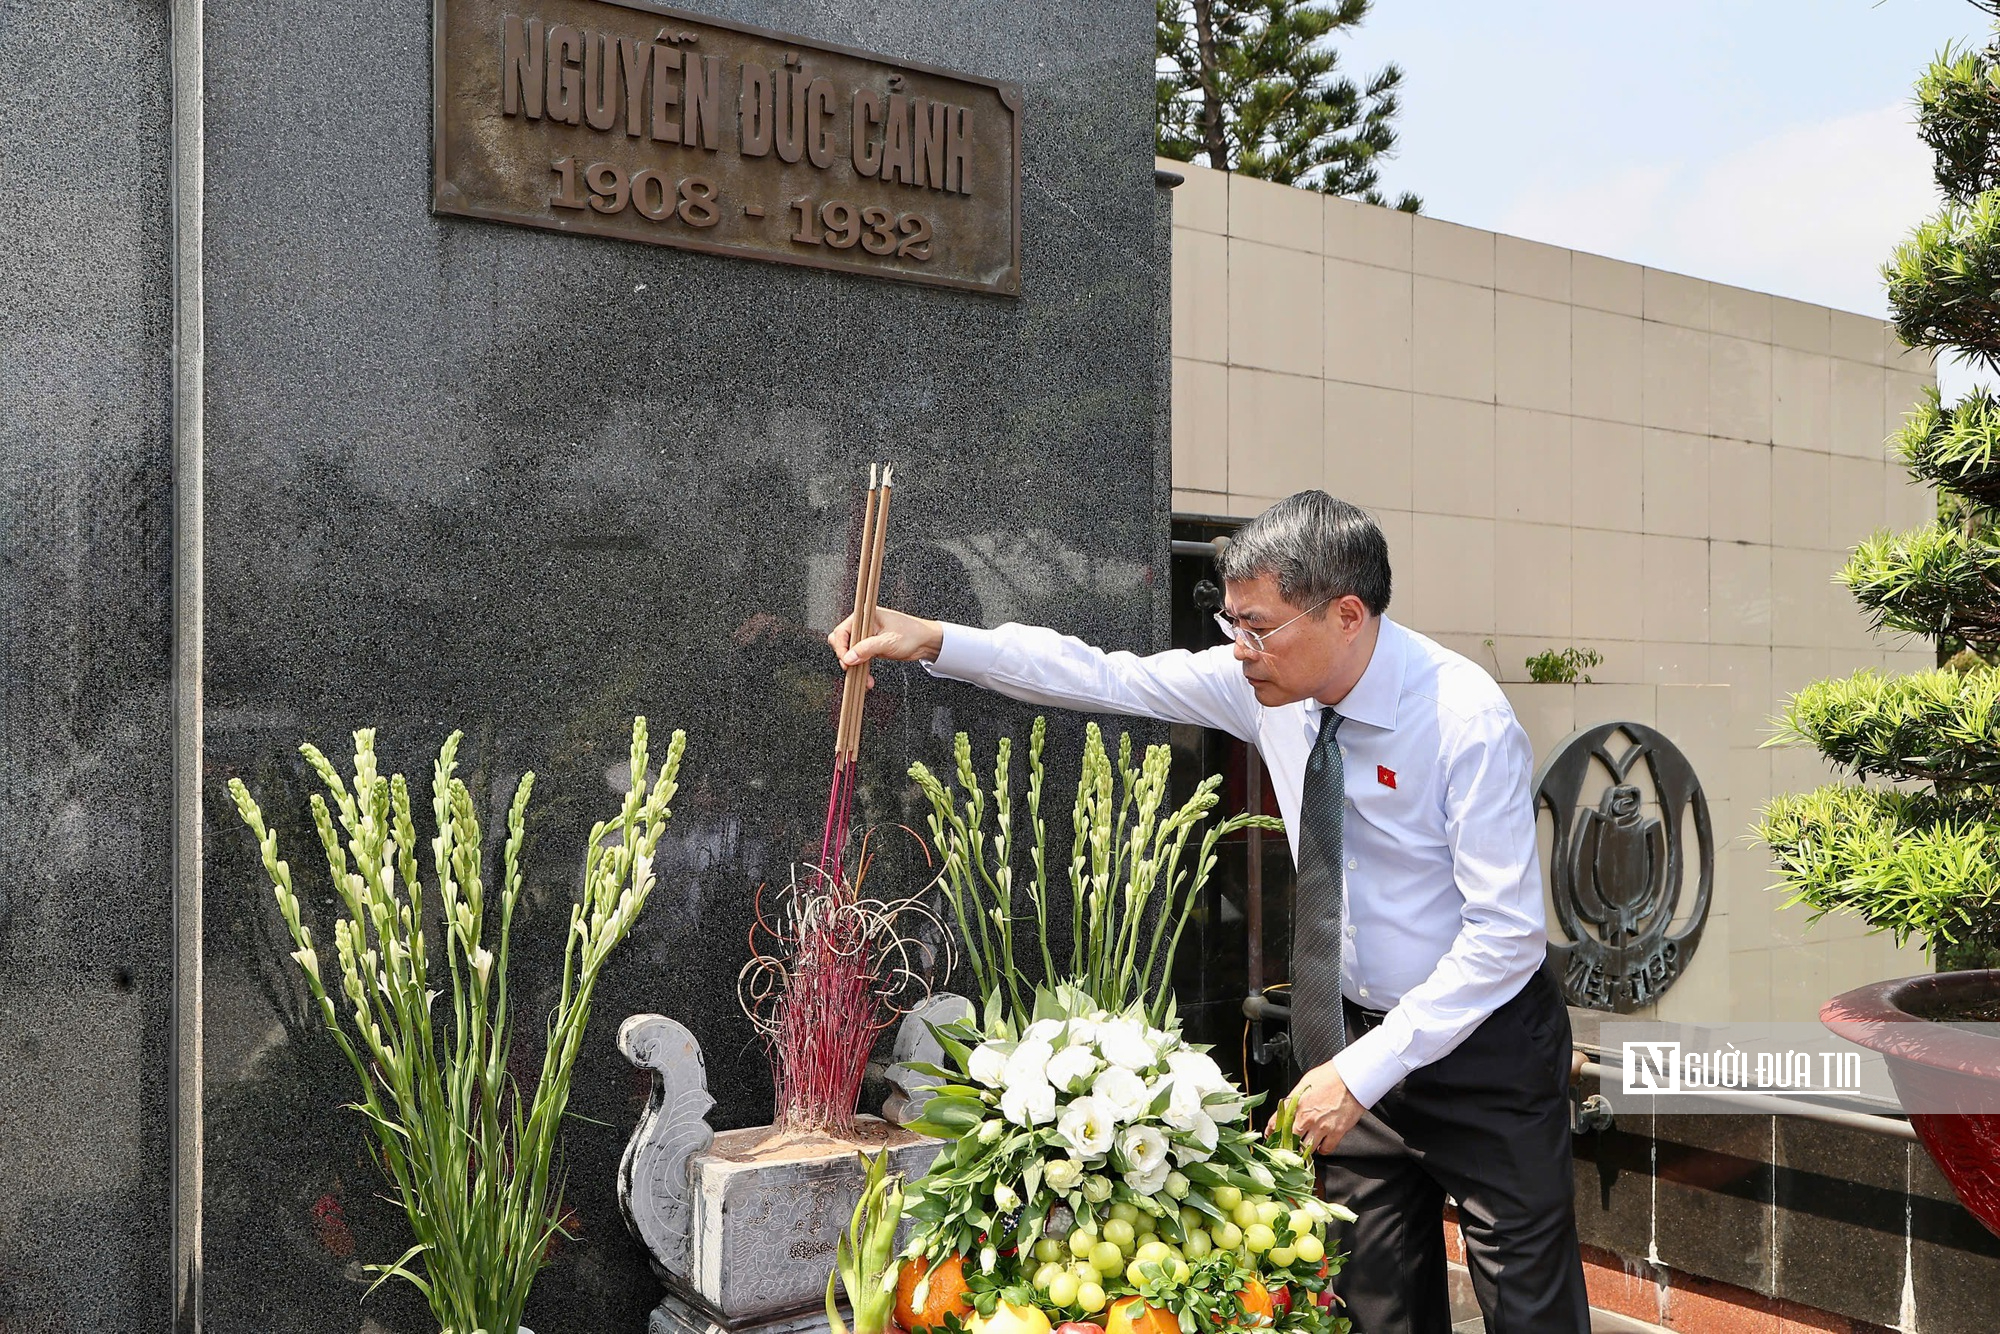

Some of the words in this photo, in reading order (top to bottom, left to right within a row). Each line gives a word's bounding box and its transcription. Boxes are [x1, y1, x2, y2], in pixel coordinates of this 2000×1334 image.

[502, 15, 719, 150] NGUYỄN
[738, 52, 836, 169] ĐỨC
[851, 73, 974, 195] CẢNH
[550, 157, 720, 227] 1908
[791, 197, 934, 261] 1932
